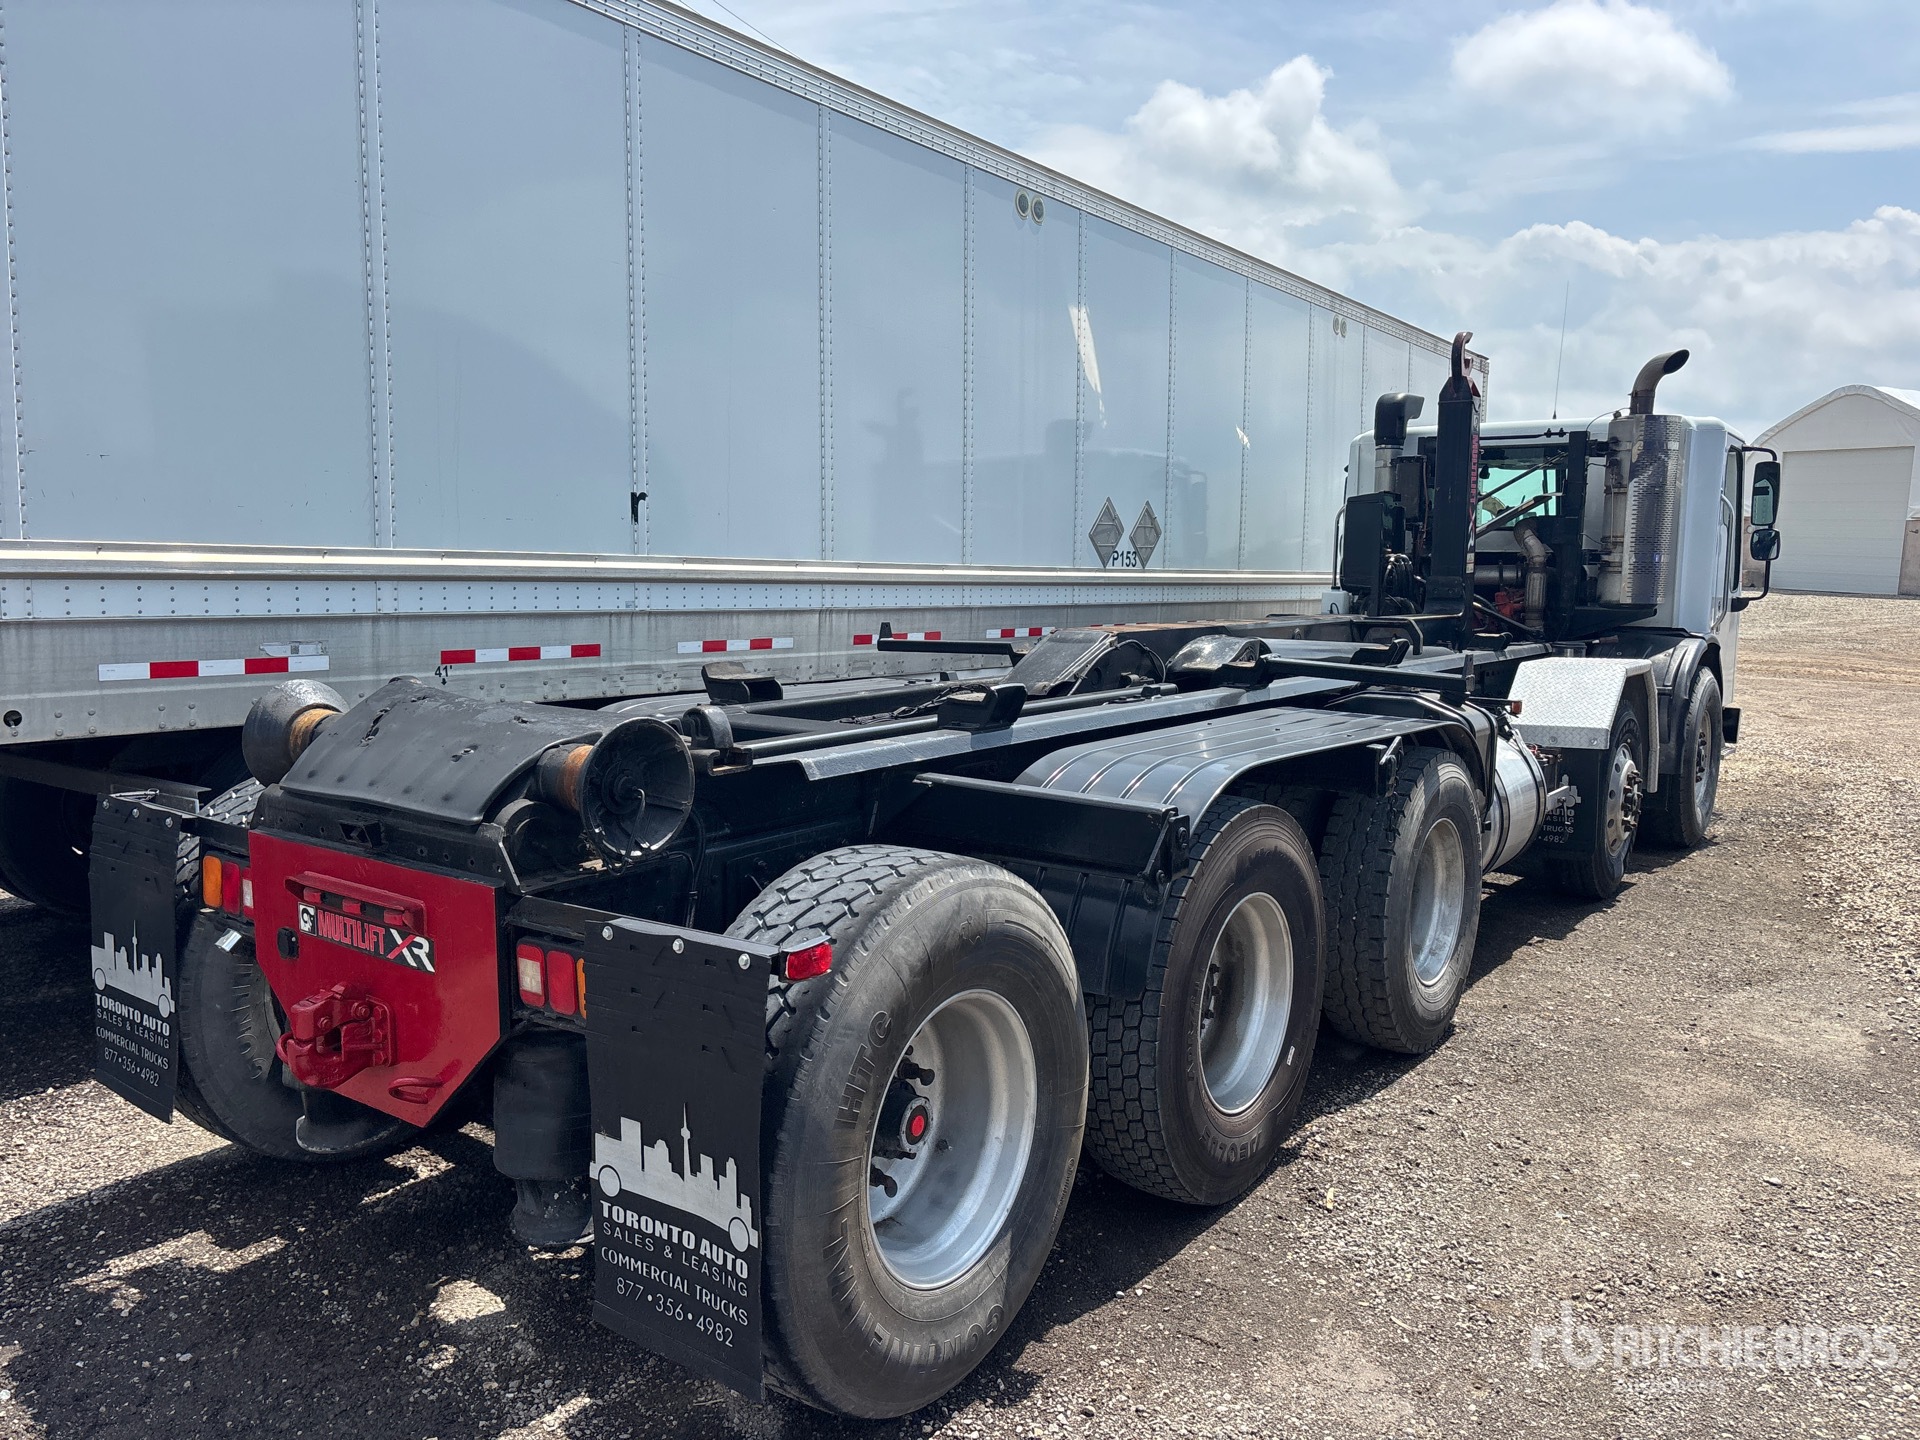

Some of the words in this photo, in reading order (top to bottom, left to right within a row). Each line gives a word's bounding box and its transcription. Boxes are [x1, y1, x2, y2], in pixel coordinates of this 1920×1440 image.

[1111, 550, 1137, 568] P153
[317, 909, 385, 955] MULTILIFT
[95, 992, 141, 1024] TORONTO
[142, 1013, 170, 1037] AUTO
[96, 1008, 123, 1027] SALES
[125, 1020, 131, 1031] &
[134, 1024, 170, 1049] LEASING
[96, 1026, 140, 1056] COMMERCIAL
[140, 1046, 169, 1070] TRUCKS
[599, 1200, 697, 1250] TORONTO
[699, 1236, 749, 1280] AUTO
[603, 1222, 655, 1252] SALES
[663, 1244, 674, 1259] &
[682, 1250, 749, 1298] LEASING
[601, 1246, 691, 1297] COMMERCIAL
[694, 1284, 749, 1327] TRUCKS
